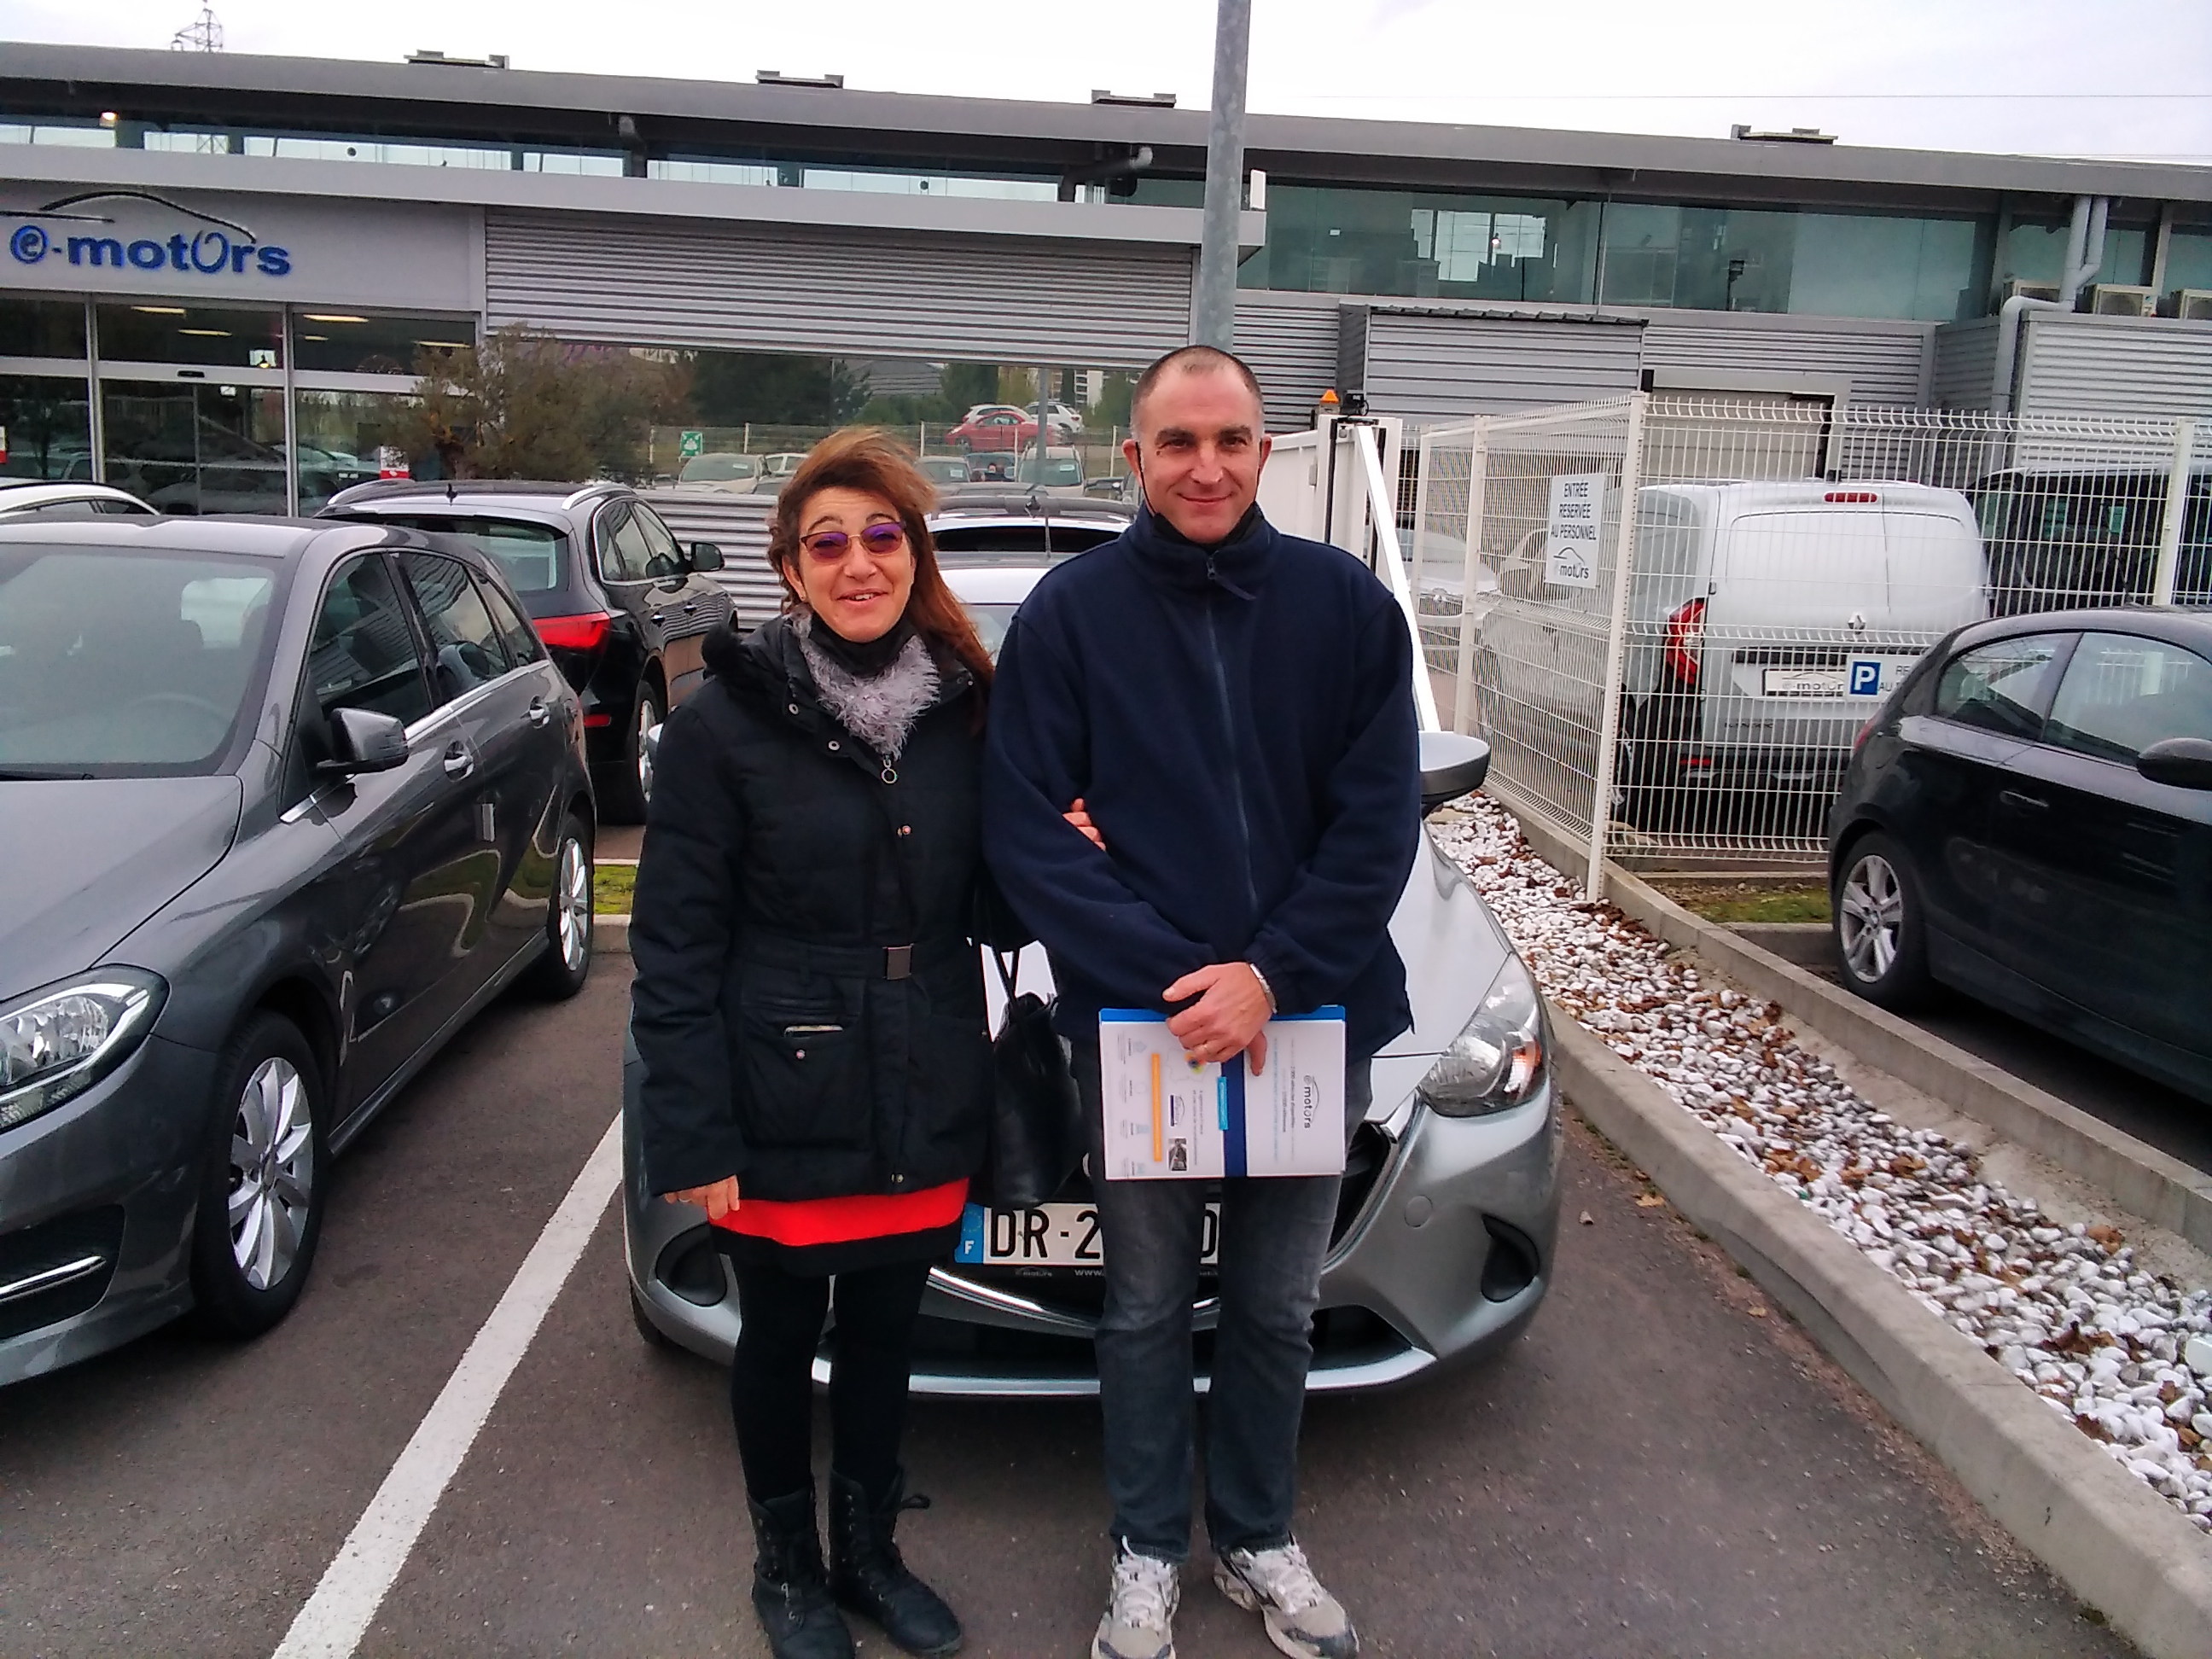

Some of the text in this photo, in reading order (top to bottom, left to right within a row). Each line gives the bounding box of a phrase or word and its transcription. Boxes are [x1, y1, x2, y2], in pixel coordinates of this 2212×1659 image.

[1551, 524, 1596, 539] AU PERSONNEL
[963, 1240, 974, 1254] F
